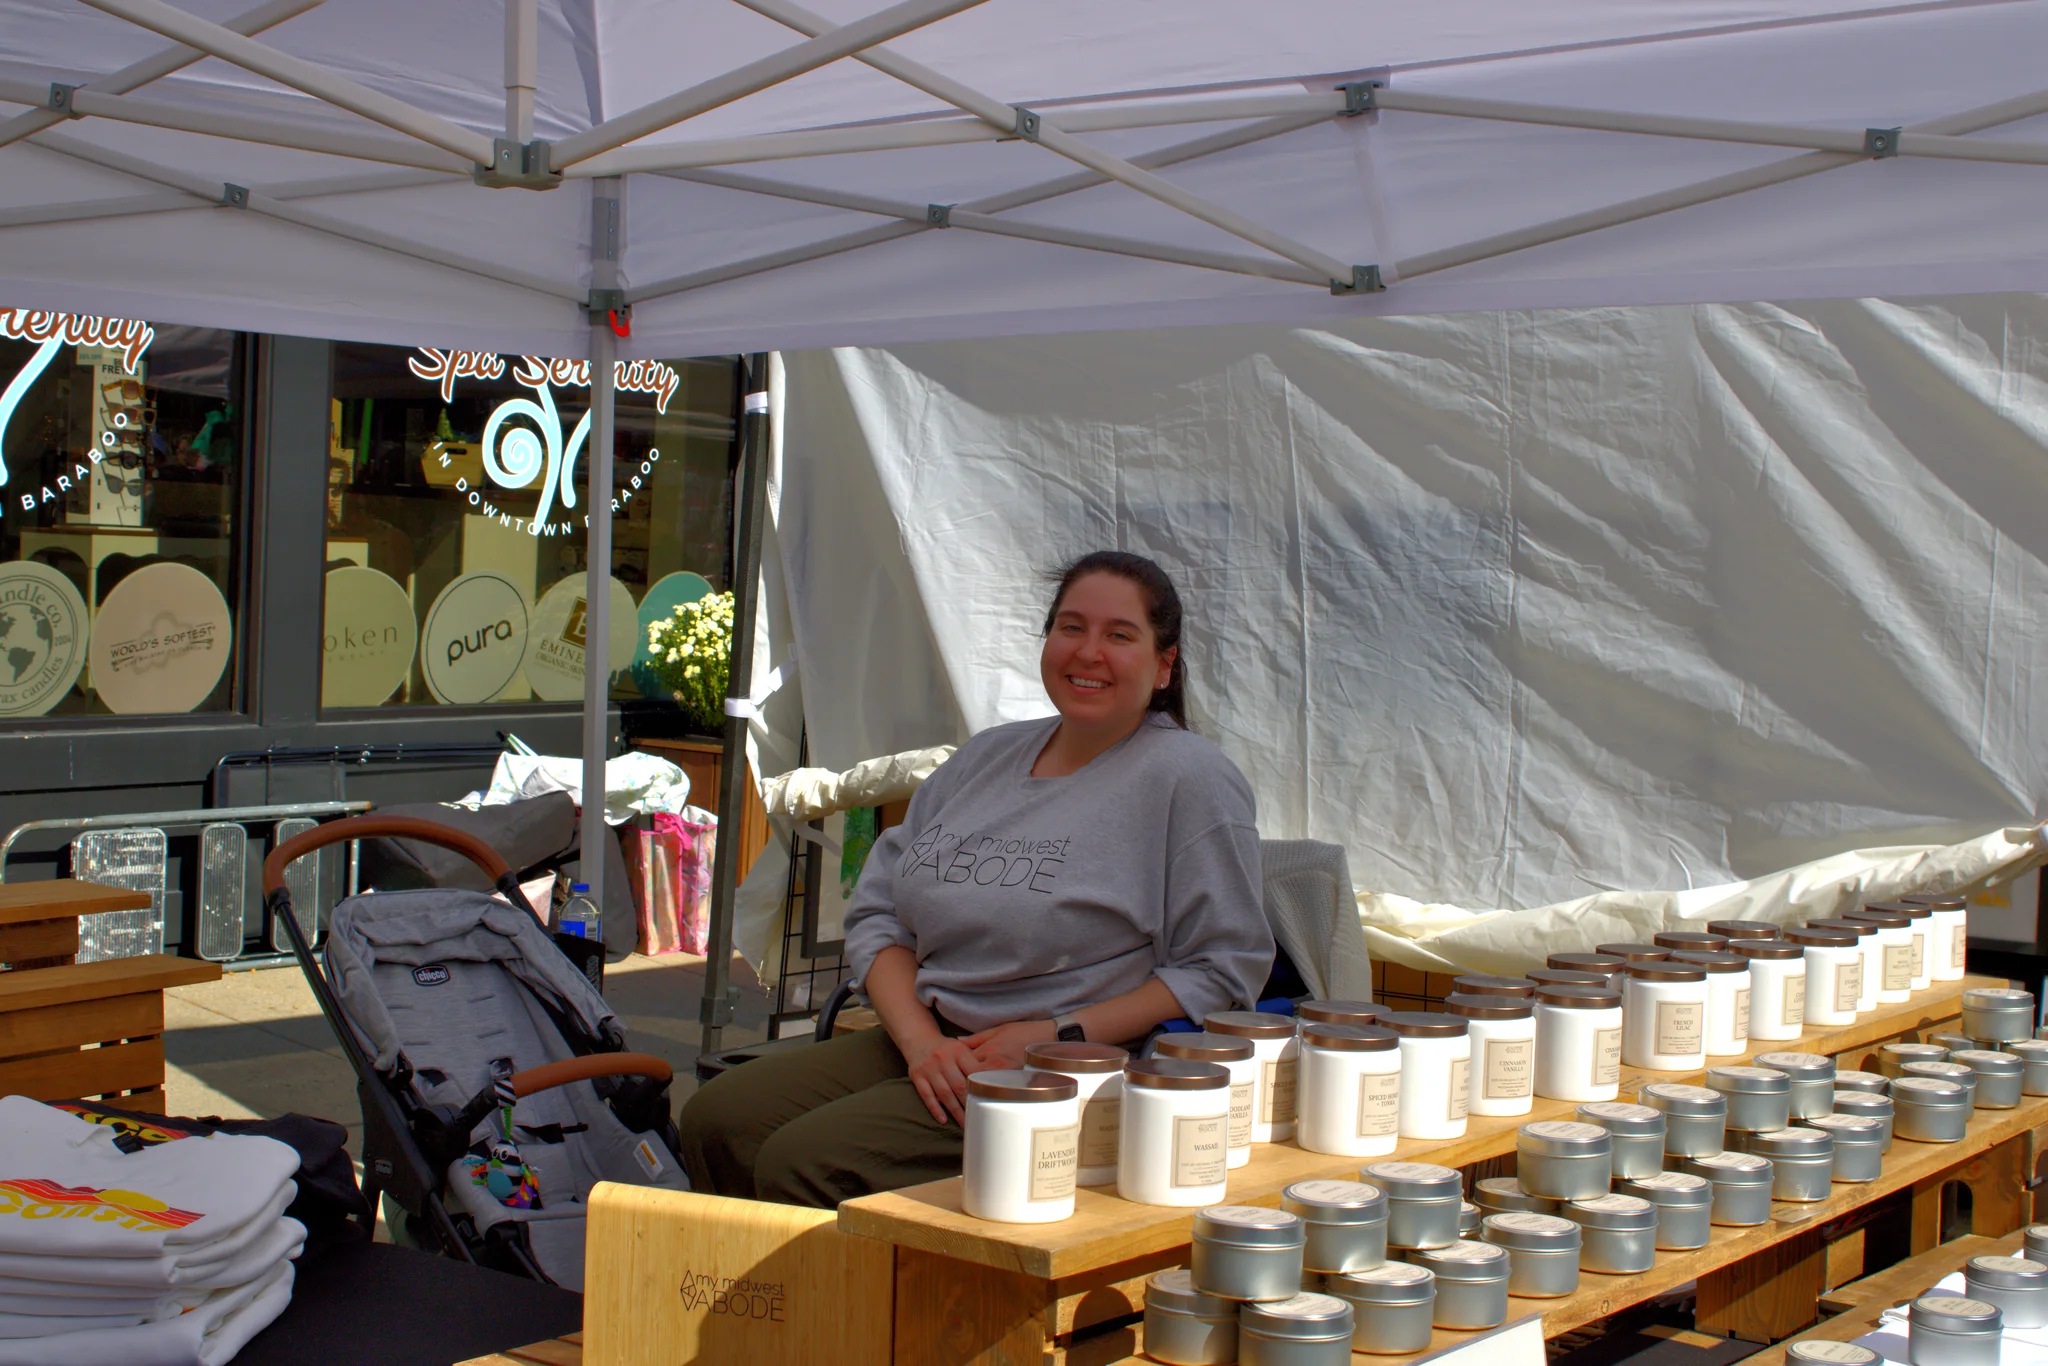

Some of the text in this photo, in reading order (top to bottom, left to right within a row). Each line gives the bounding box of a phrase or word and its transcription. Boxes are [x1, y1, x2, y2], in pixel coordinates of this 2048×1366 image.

[102, 363, 139, 377] FREYS
[408, 346, 679, 415] Spa Sernity
[21, 413, 128, 511] BARABOO
[433, 441, 660, 537] IN DOWNTOWN RABOO
[110, 638, 159, 660] WORLD'S
[164, 626, 212, 646] SOFTEST
[446, 619, 513, 668] pura
[540, 638, 587, 664] EMINE
[21, 656, 63, 700] candles
[937, 832, 1072, 857] my midwest
[910, 849, 1065, 895] ABODE
[695, 1273, 785, 1297] my midwest
[693, 1289, 785, 1323] ABODE
